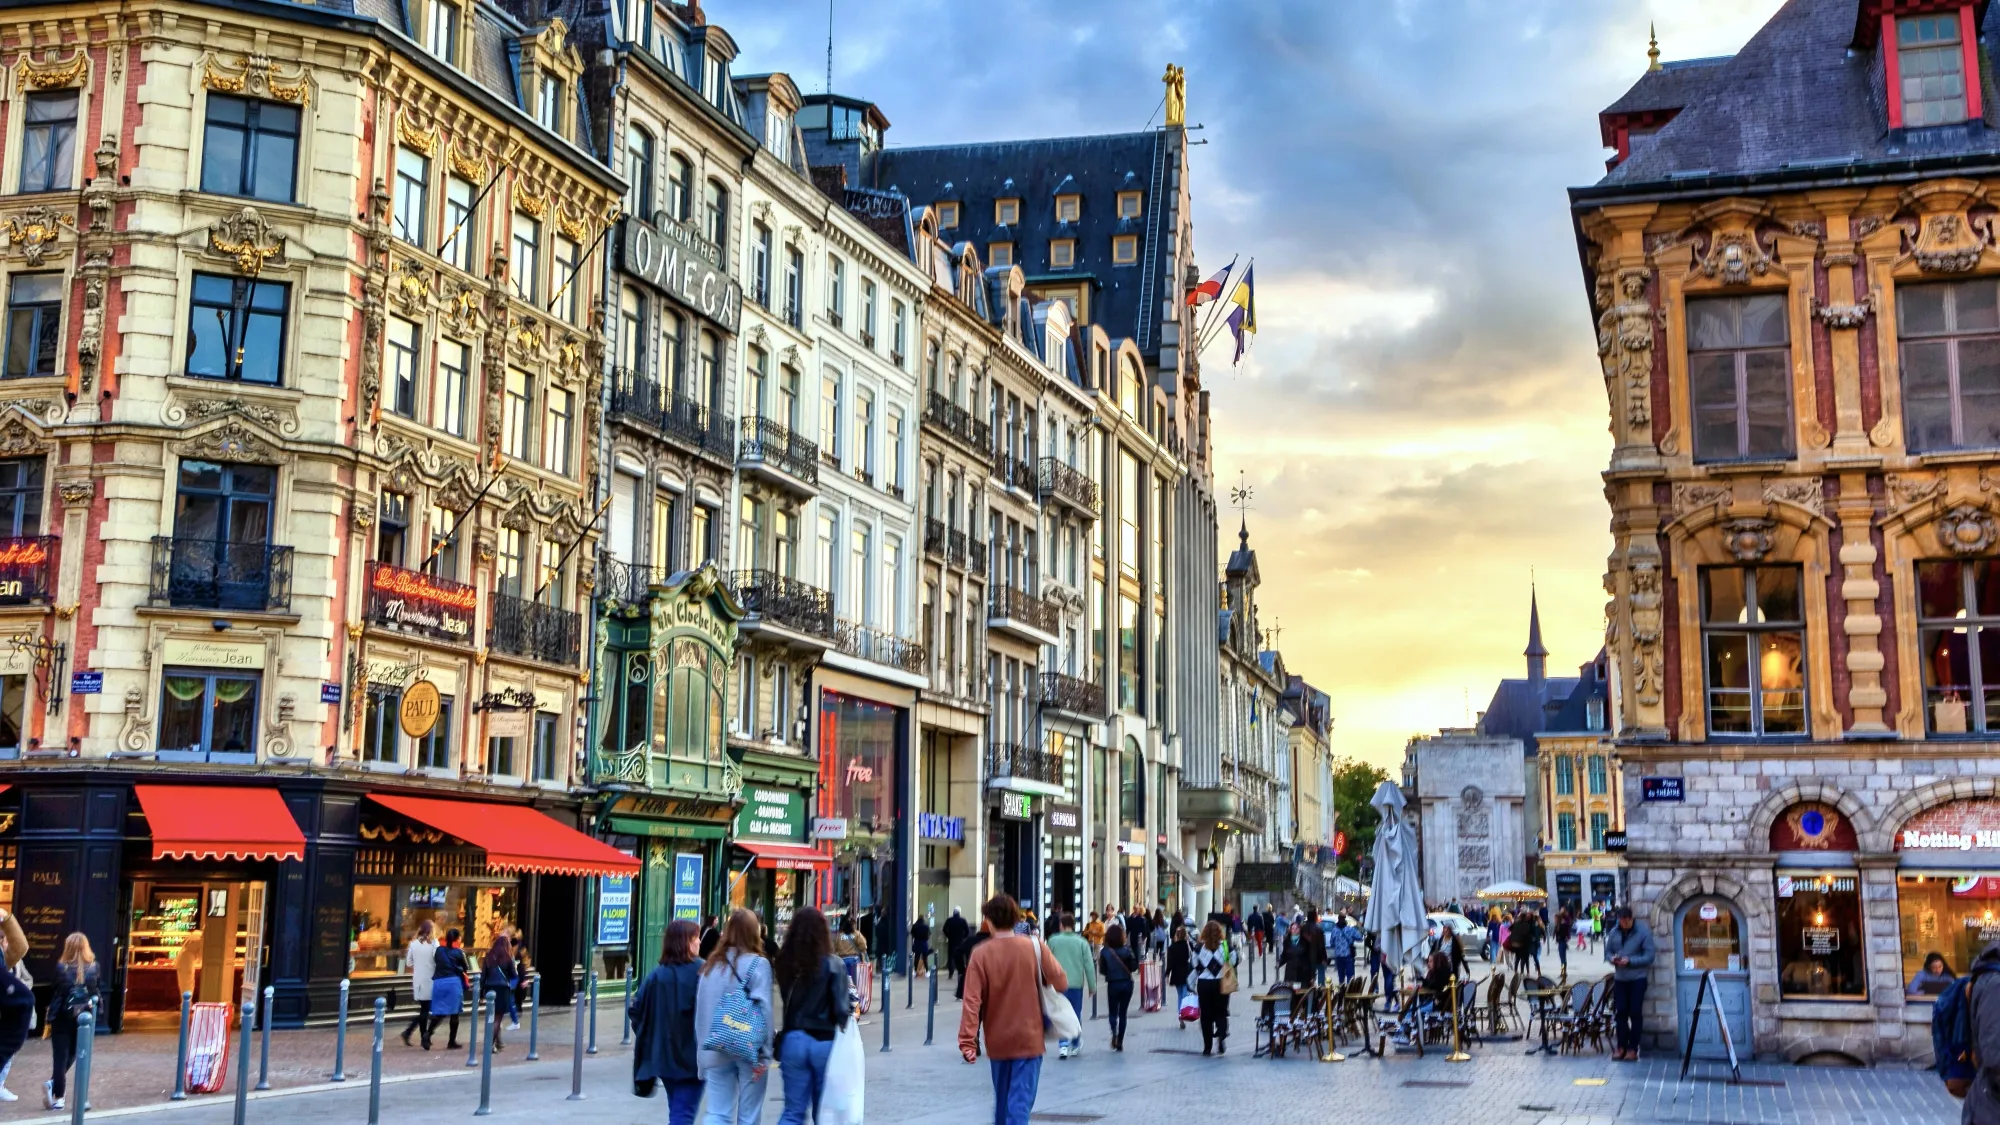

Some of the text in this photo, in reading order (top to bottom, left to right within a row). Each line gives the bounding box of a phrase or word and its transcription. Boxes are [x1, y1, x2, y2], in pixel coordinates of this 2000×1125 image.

[663, 218, 715, 263] MONTRE
[635, 226, 733, 326] OMEGA
[440, 611, 467, 635] Jean
[223, 652, 253, 664] Jean
[405, 699, 436, 718] PAUL
[845, 758, 873, 787] free
[818, 823, 842, 834] free
[1053, 811, 1077, 828] SEPHORA
[1903, 830, 1973, 851] Notting
[1792, 879, 1855, 894] otting Hill
[609, 908, 627, 919] LOUER
